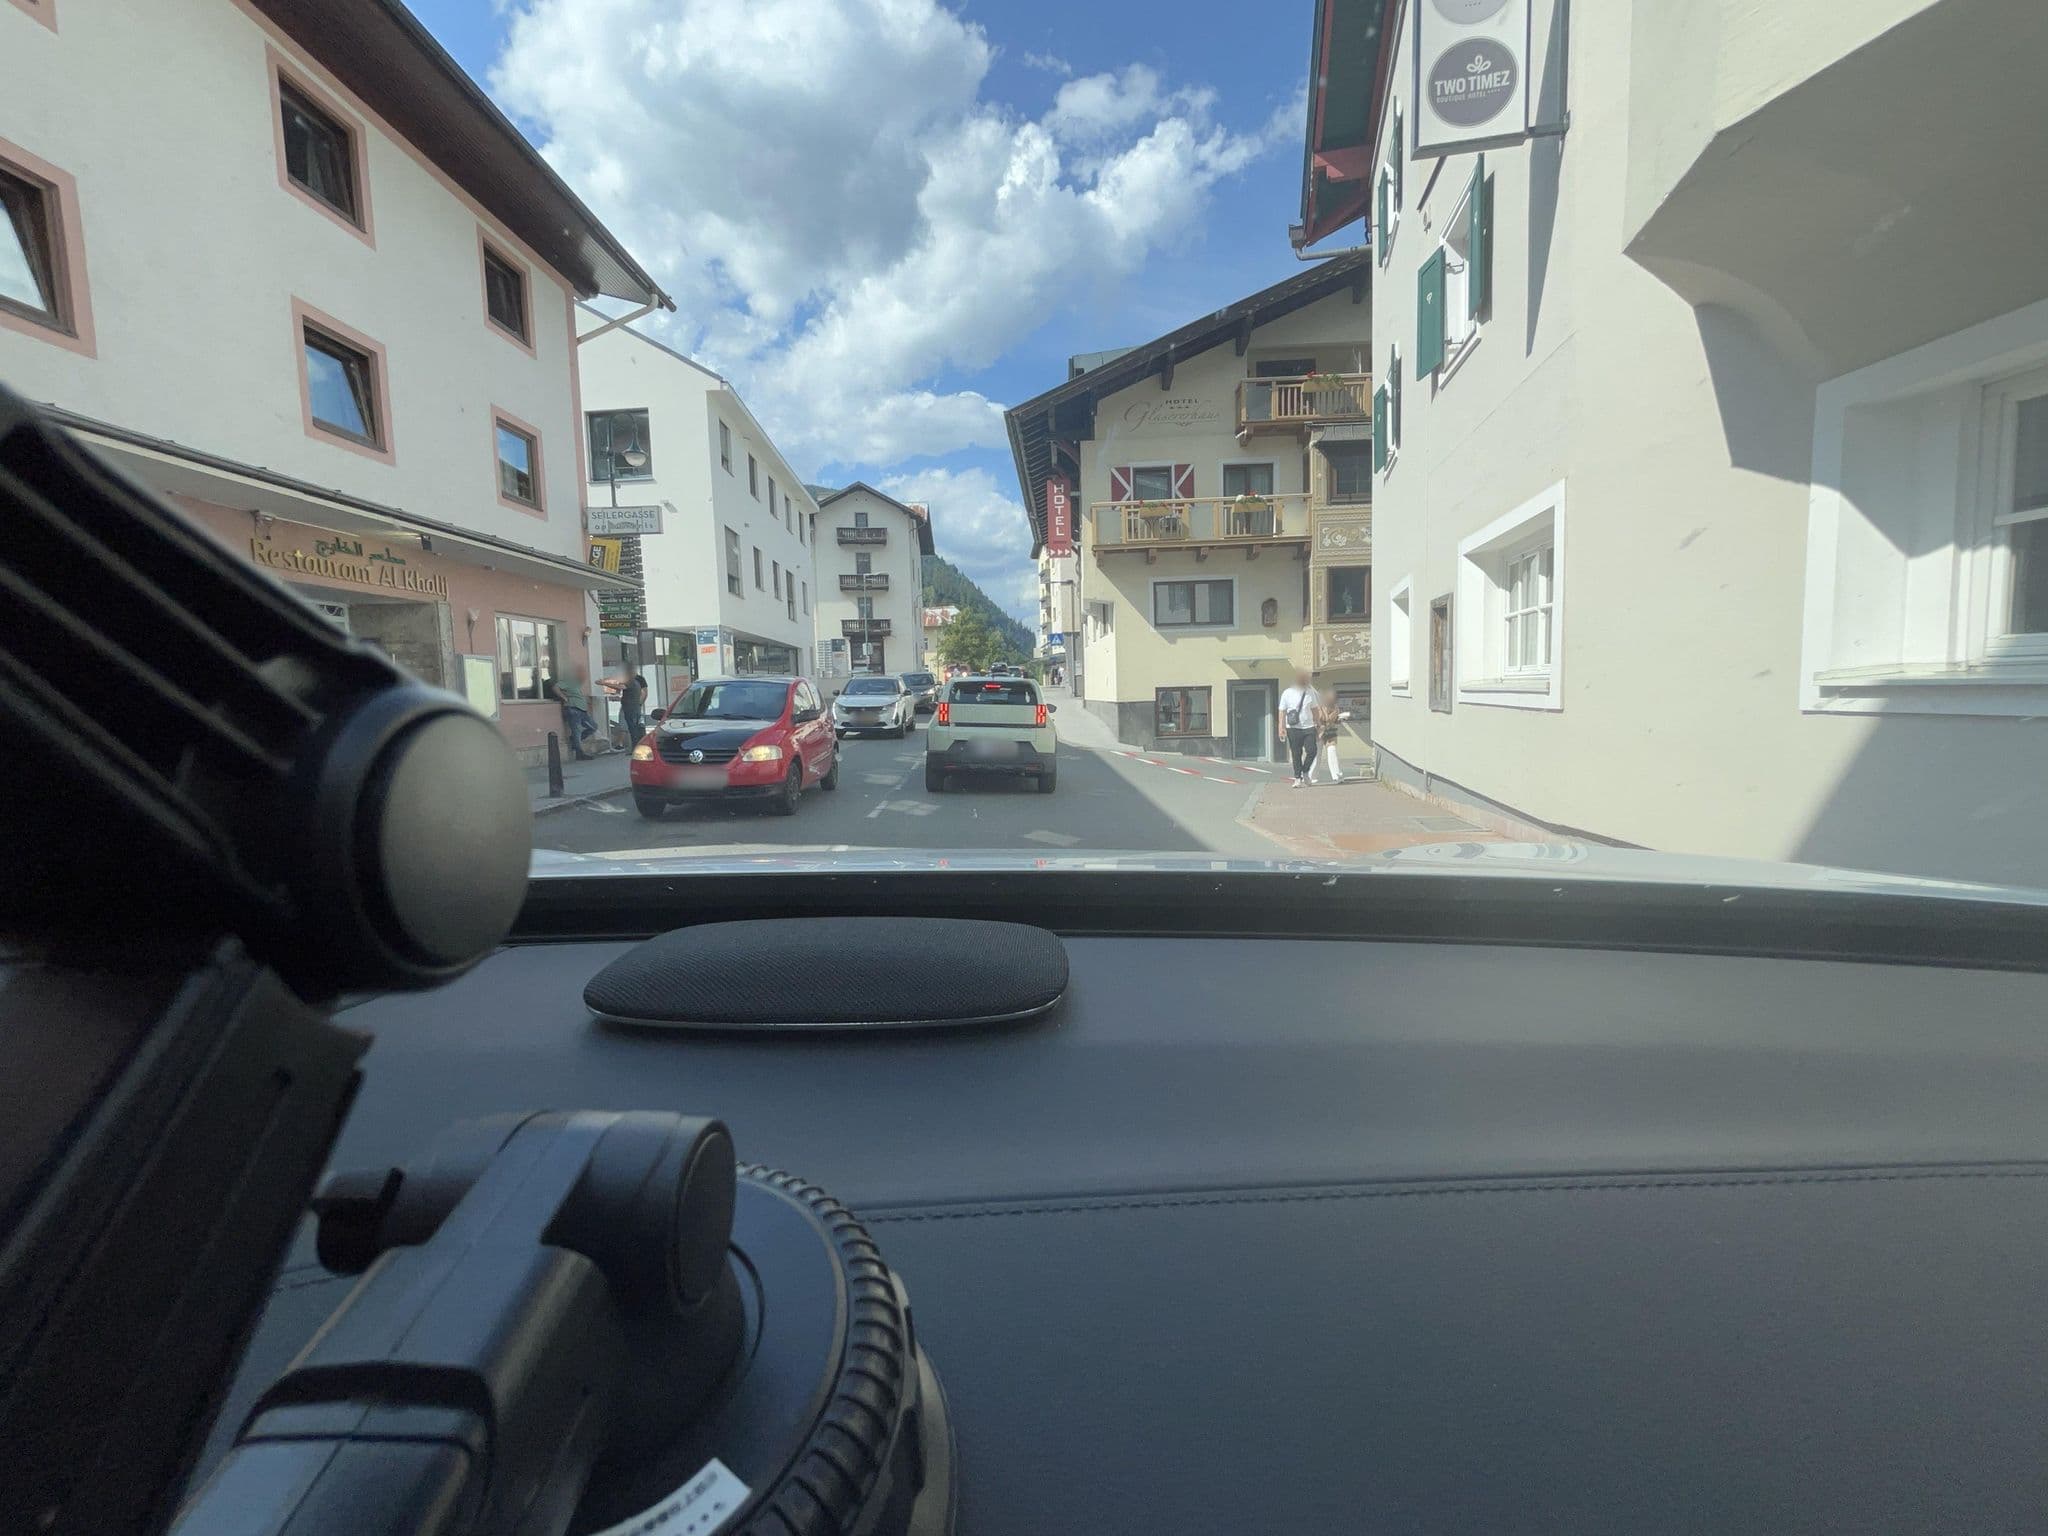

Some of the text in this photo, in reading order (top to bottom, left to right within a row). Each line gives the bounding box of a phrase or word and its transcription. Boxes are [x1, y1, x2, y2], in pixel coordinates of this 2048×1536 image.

[1434, 70, 1510, 96] TWO TIMEZ
[1436, 91, 1486, 104] BOUTIQUE HOTEL
[591, 510, 655, 520] SEILERGASSE
[1053, 484, 1065, 536] HOTEL
[250, 538, 374, 584] Restaurant
